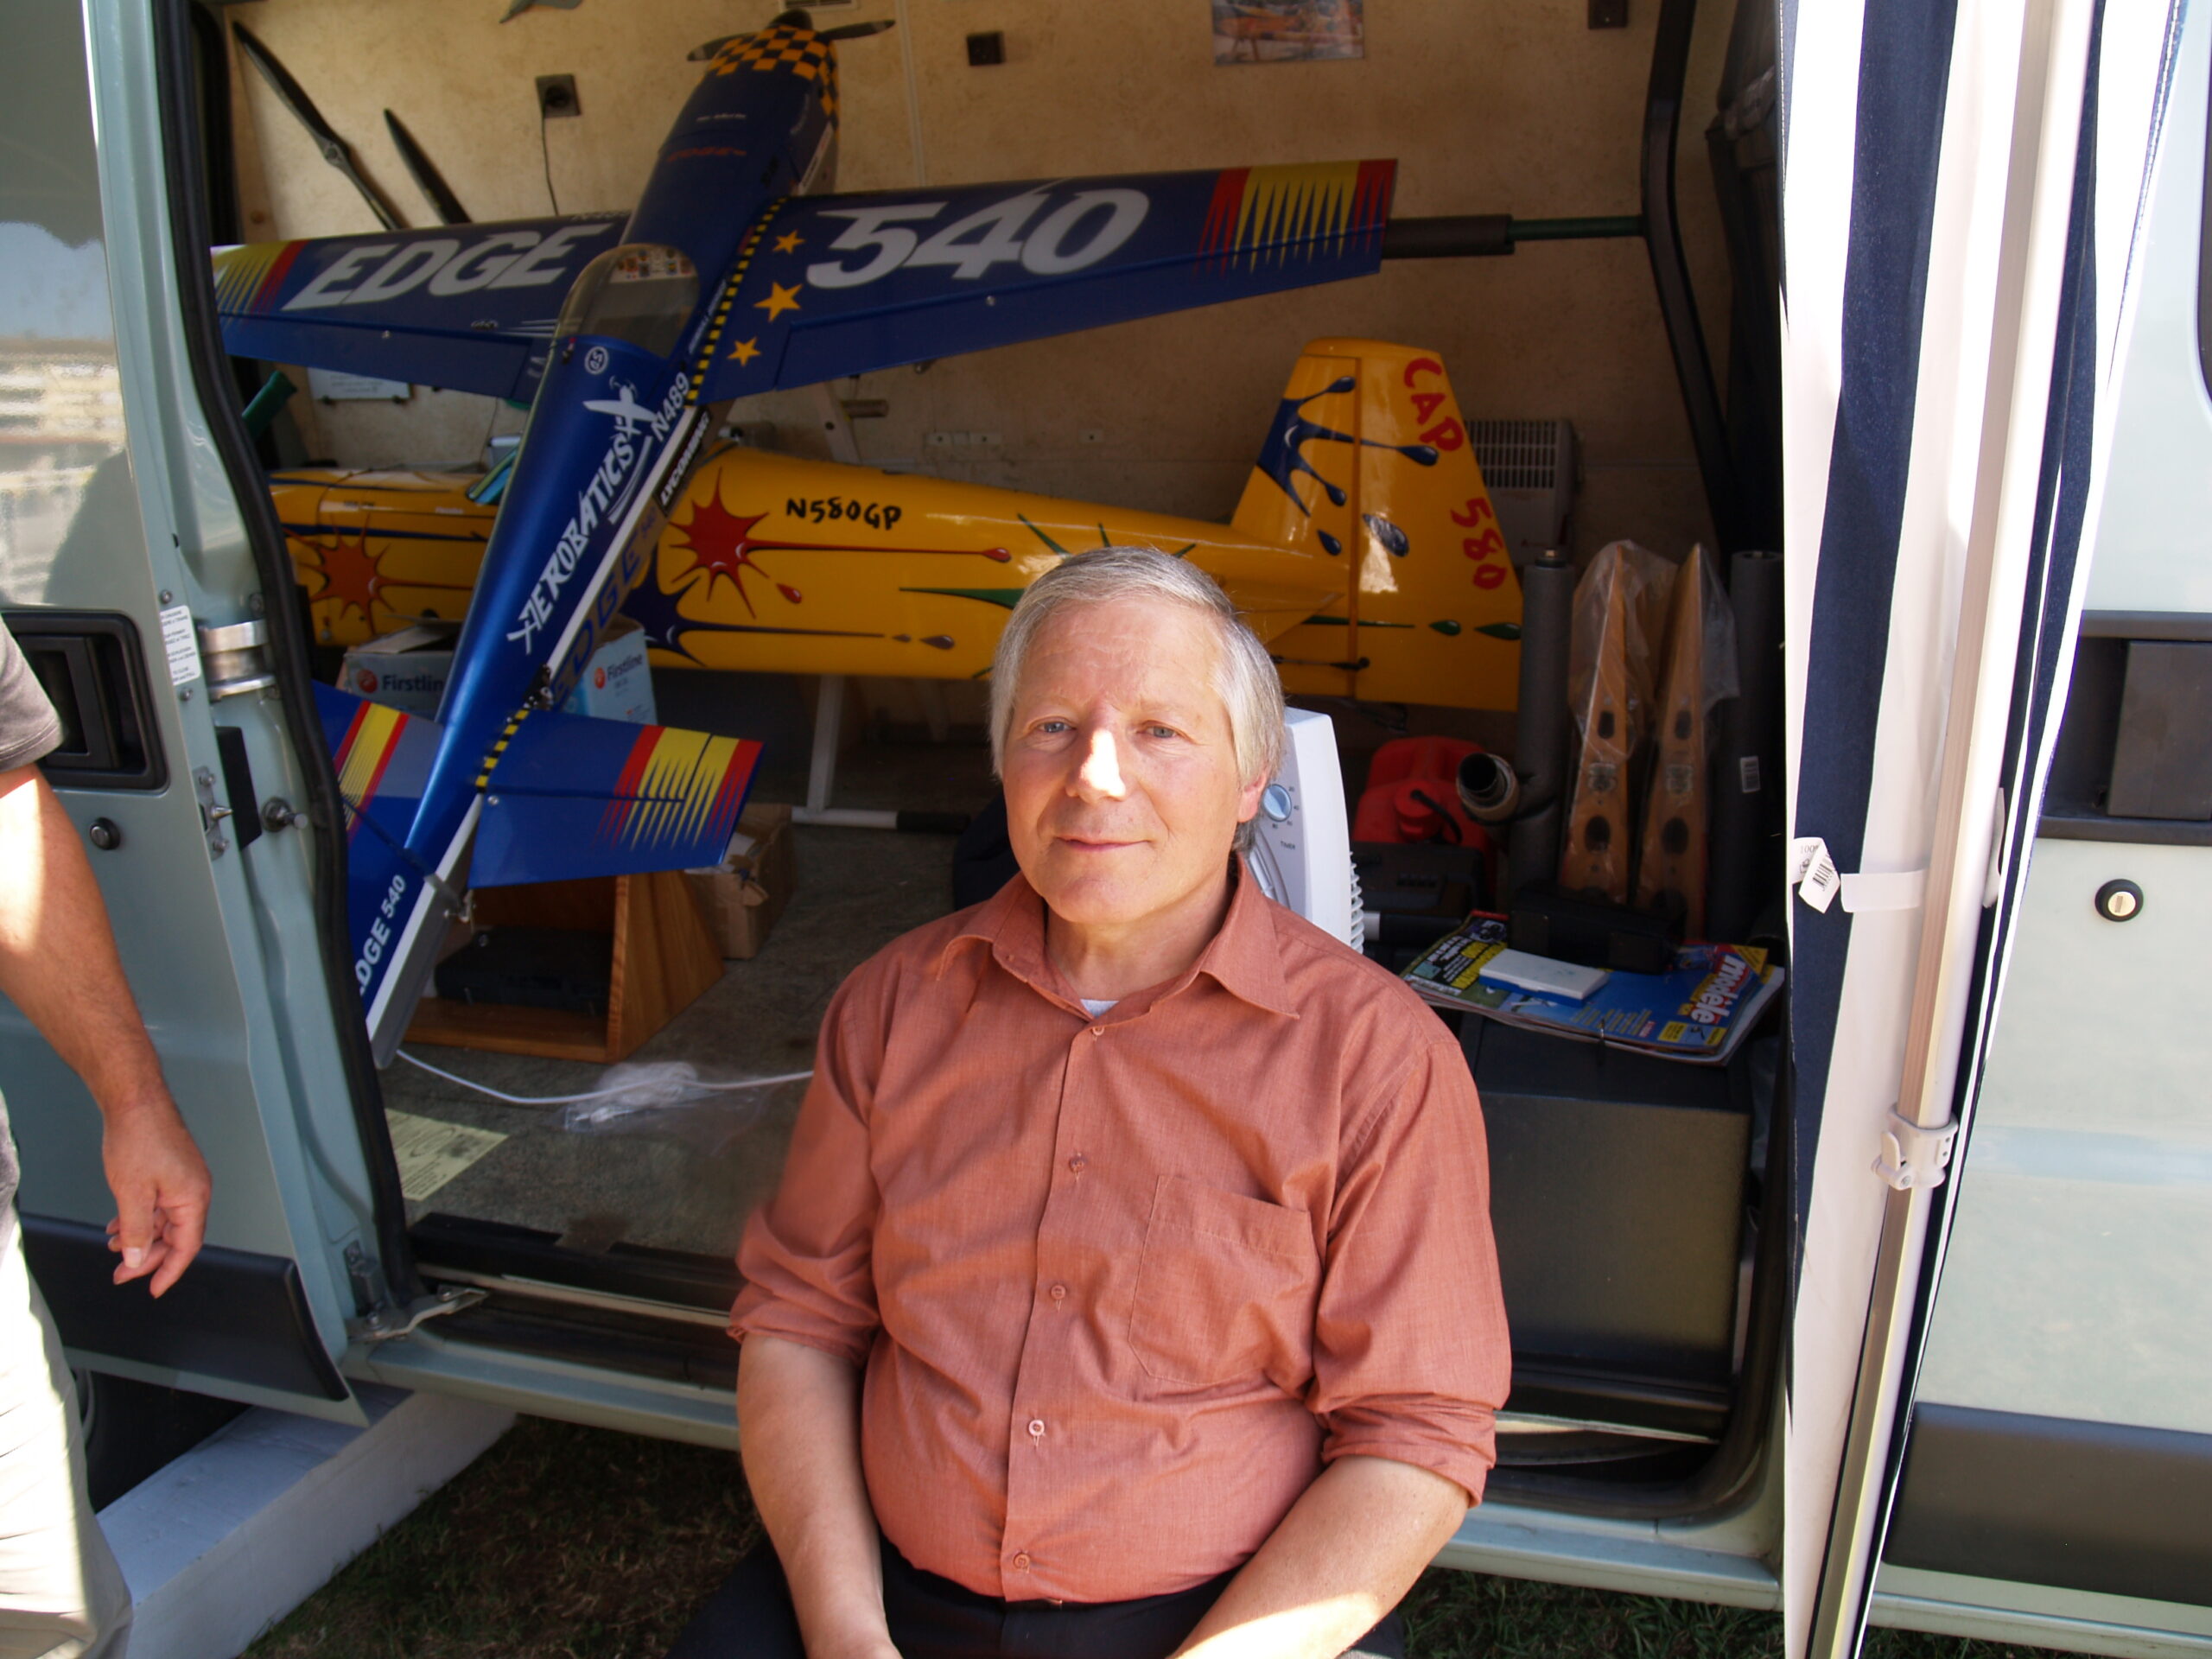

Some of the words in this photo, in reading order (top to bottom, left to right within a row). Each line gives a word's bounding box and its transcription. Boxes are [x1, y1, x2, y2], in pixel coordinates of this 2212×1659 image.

[283, 223, 620, 311] EDGE
[806, 179, 1151, 289] 540
[650, 372, 691, 442] N489
[659, 411, 711, 507] LYCOMING
[785, 495, 902, 531] N580GP
[1404, 356, 1462, 454] CAP
[1451, 496, 1507, 590] 580
[507, 434, 635, 654] AEROBATICS
[382, 675, 444, 693] Firstlin
[355, 914, 391, 995] DGE
[380, 873, 406, 921] 540
